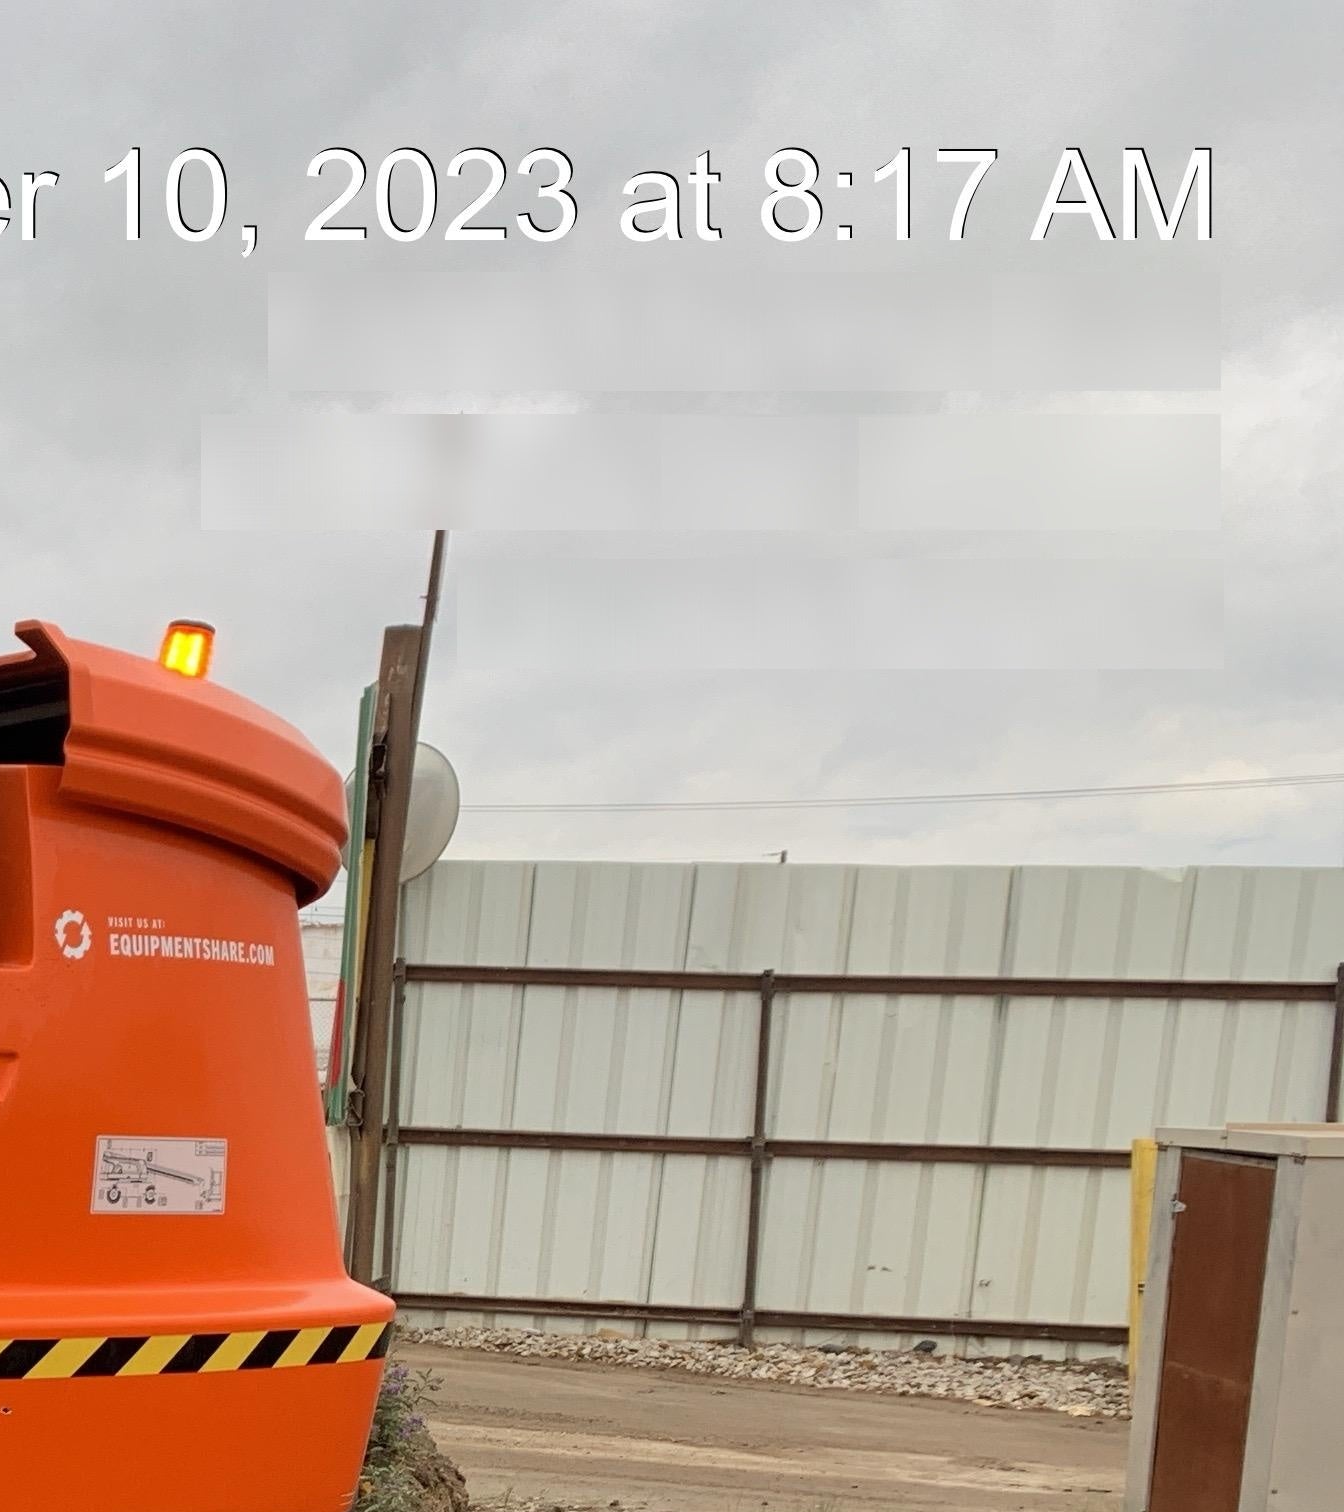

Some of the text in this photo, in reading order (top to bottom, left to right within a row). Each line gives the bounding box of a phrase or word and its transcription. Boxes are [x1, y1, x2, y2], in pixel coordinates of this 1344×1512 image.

[107, 916, 133, 928] VISIT
[136, 918, 149, 929] US
[109, 933, 275, 966] EQUIPMENTSHARE.COM
